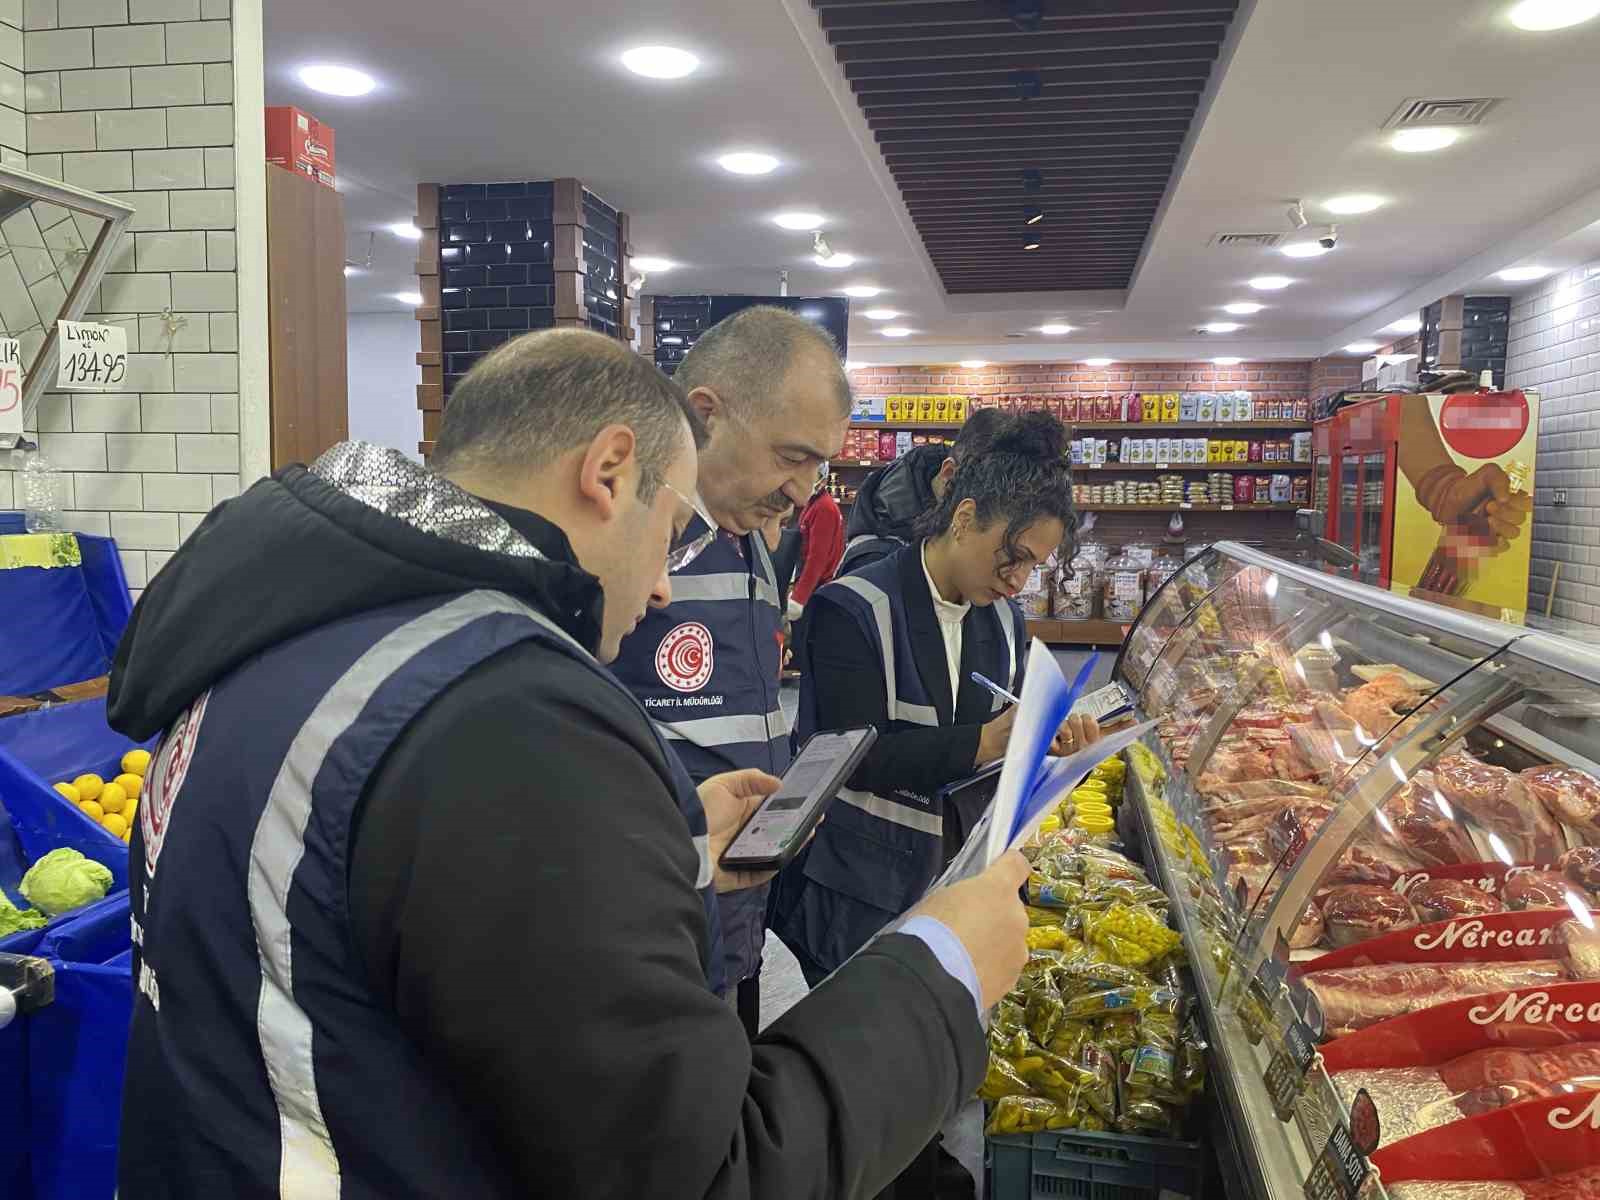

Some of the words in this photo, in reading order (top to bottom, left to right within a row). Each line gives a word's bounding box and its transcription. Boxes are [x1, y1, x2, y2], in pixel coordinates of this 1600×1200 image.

[0, 341, 19, 365] IK
[64, 351, 126, 384] 134.95
[645, 697, 676, 708] TİCARET
